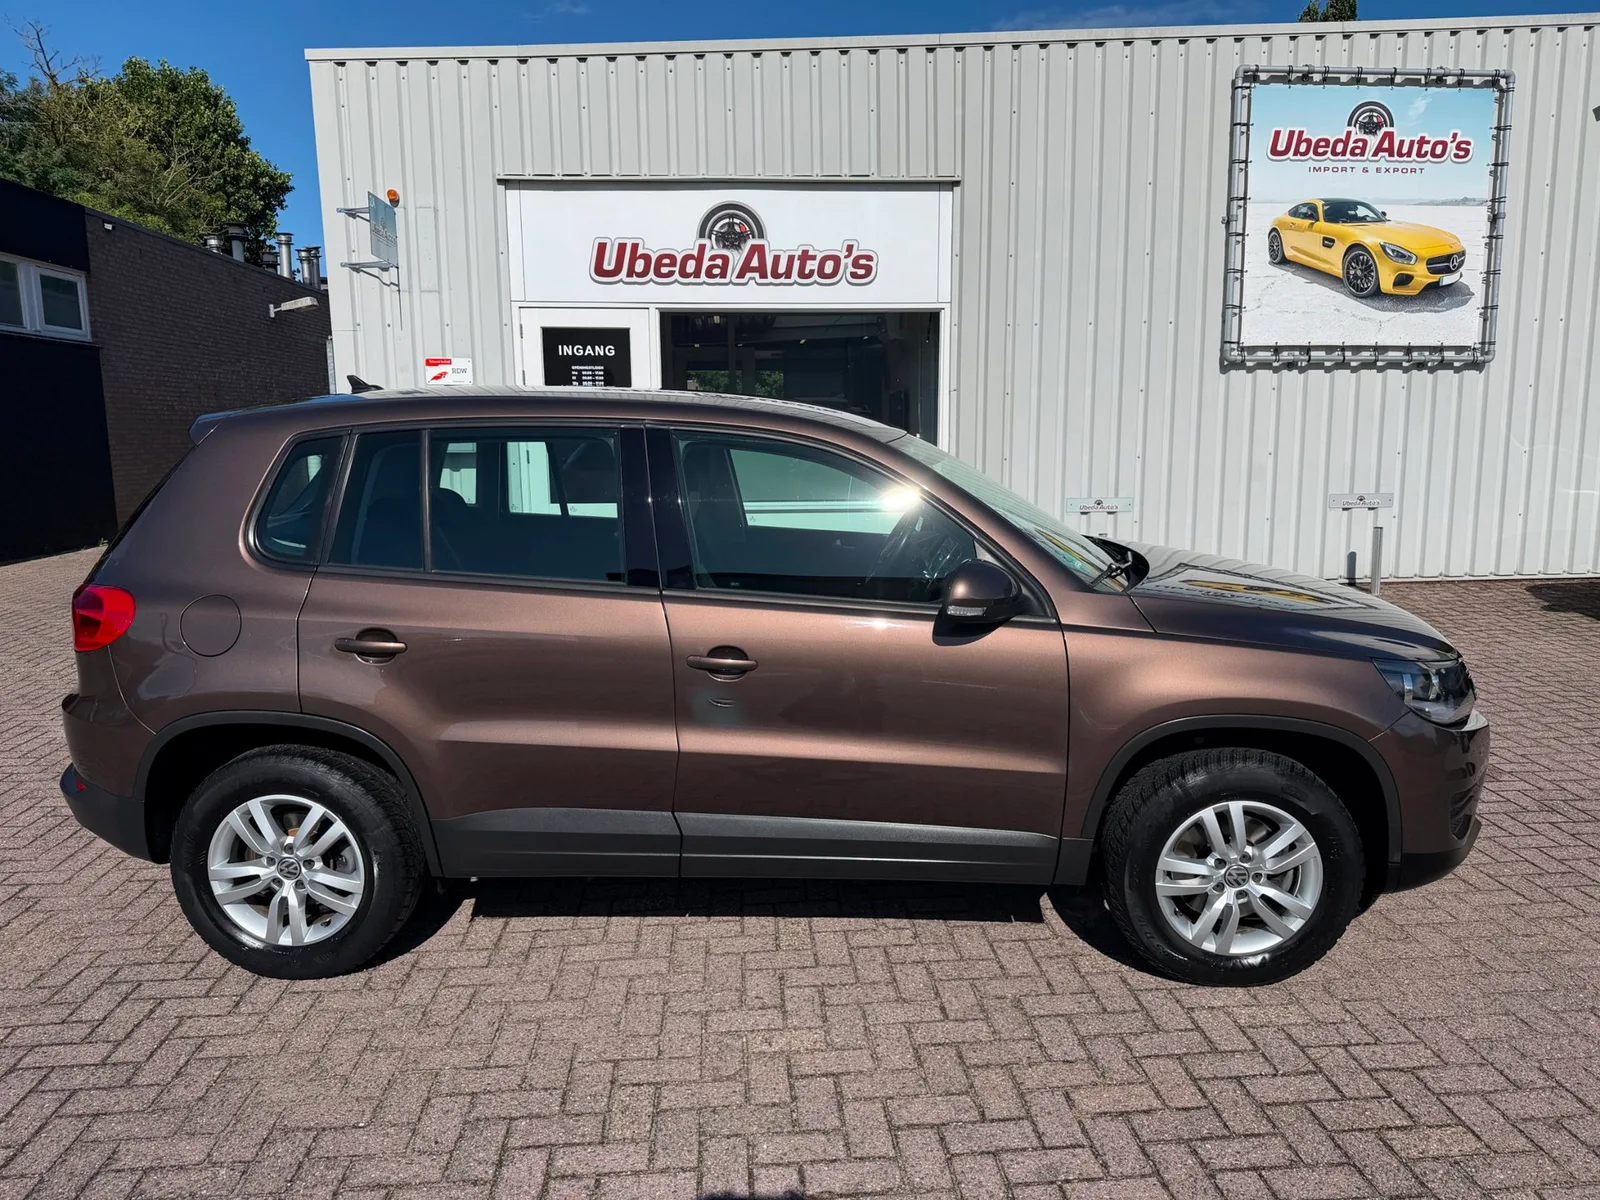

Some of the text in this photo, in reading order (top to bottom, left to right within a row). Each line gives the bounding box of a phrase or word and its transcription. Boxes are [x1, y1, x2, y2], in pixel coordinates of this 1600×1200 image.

[1269, 129, 1472, 160] Ubeda Auto's
[1362, 166, 1369, 174] &
[593, 241, 875, 281] Ubeda Auto's
[558, 344, 616, 356] INGANG
